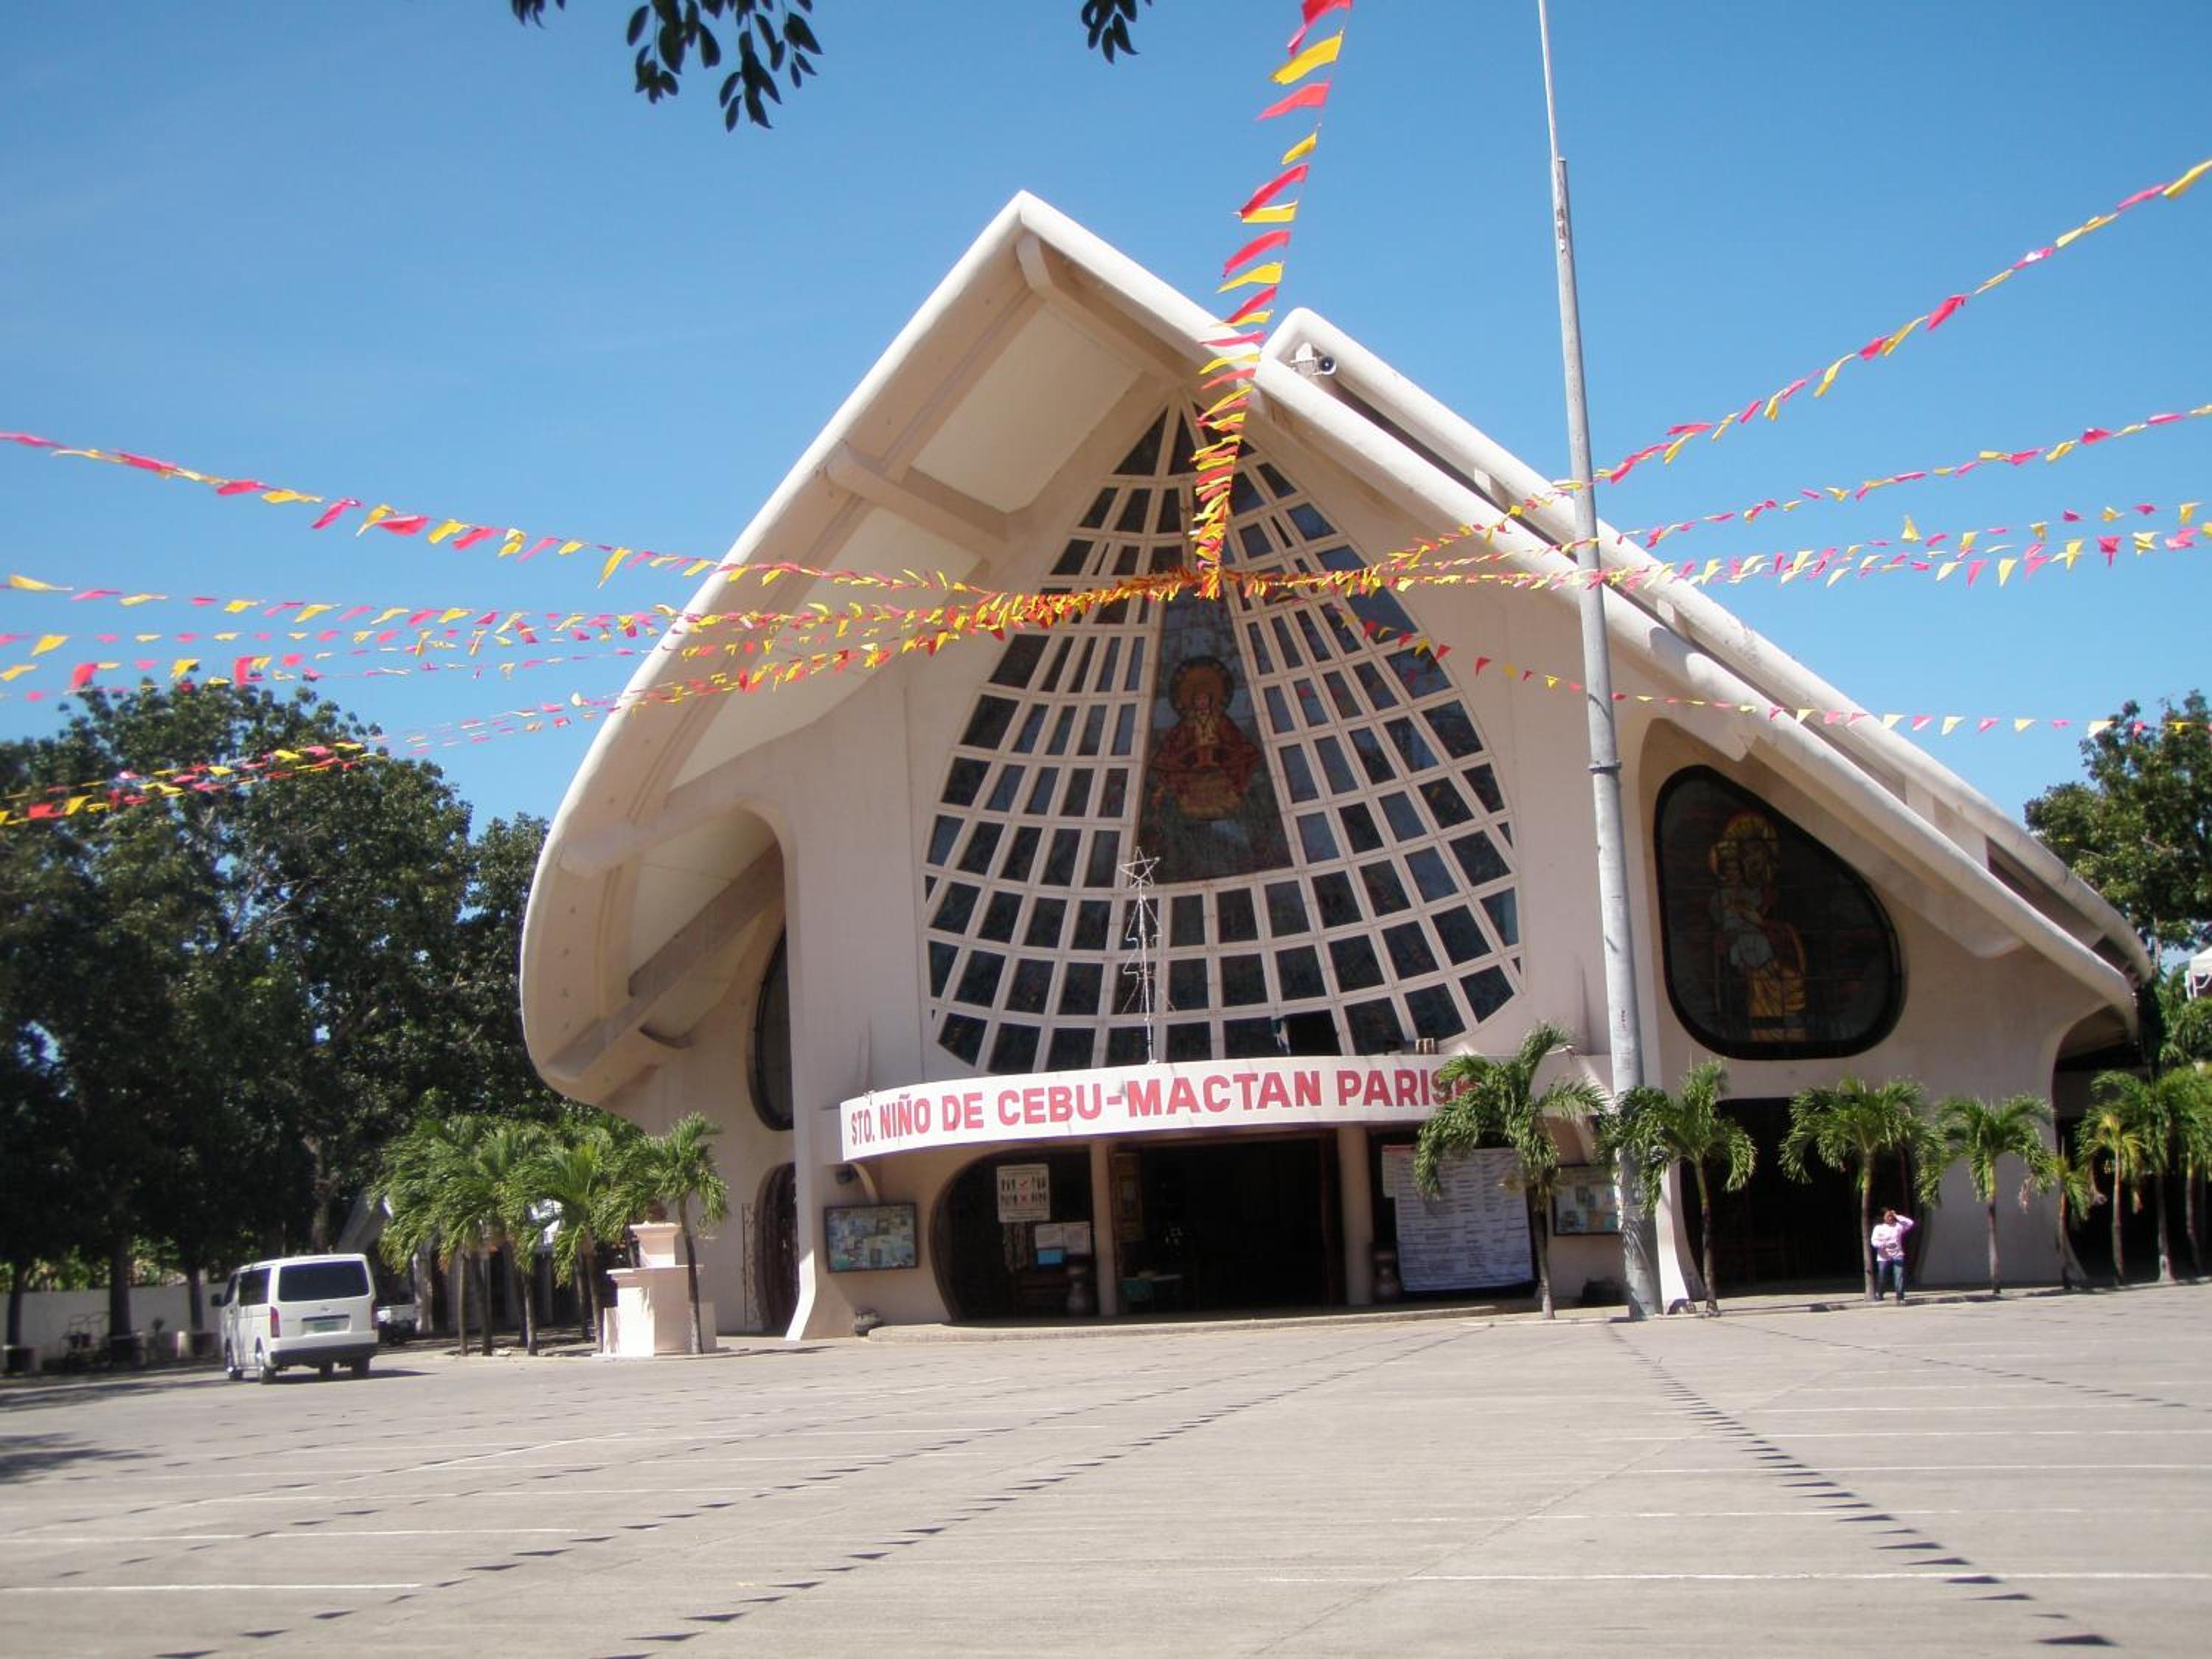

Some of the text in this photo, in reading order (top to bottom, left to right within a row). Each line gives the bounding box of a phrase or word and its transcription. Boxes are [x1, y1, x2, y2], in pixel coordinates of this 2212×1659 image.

[851, 1108, 875, 1145] STO.
[880, 1093, 931, 1140] NIÑO
[942, 1092, 984, 1132] DE
[998, 1071, 1322, 1126] CEBU-MACTAN
